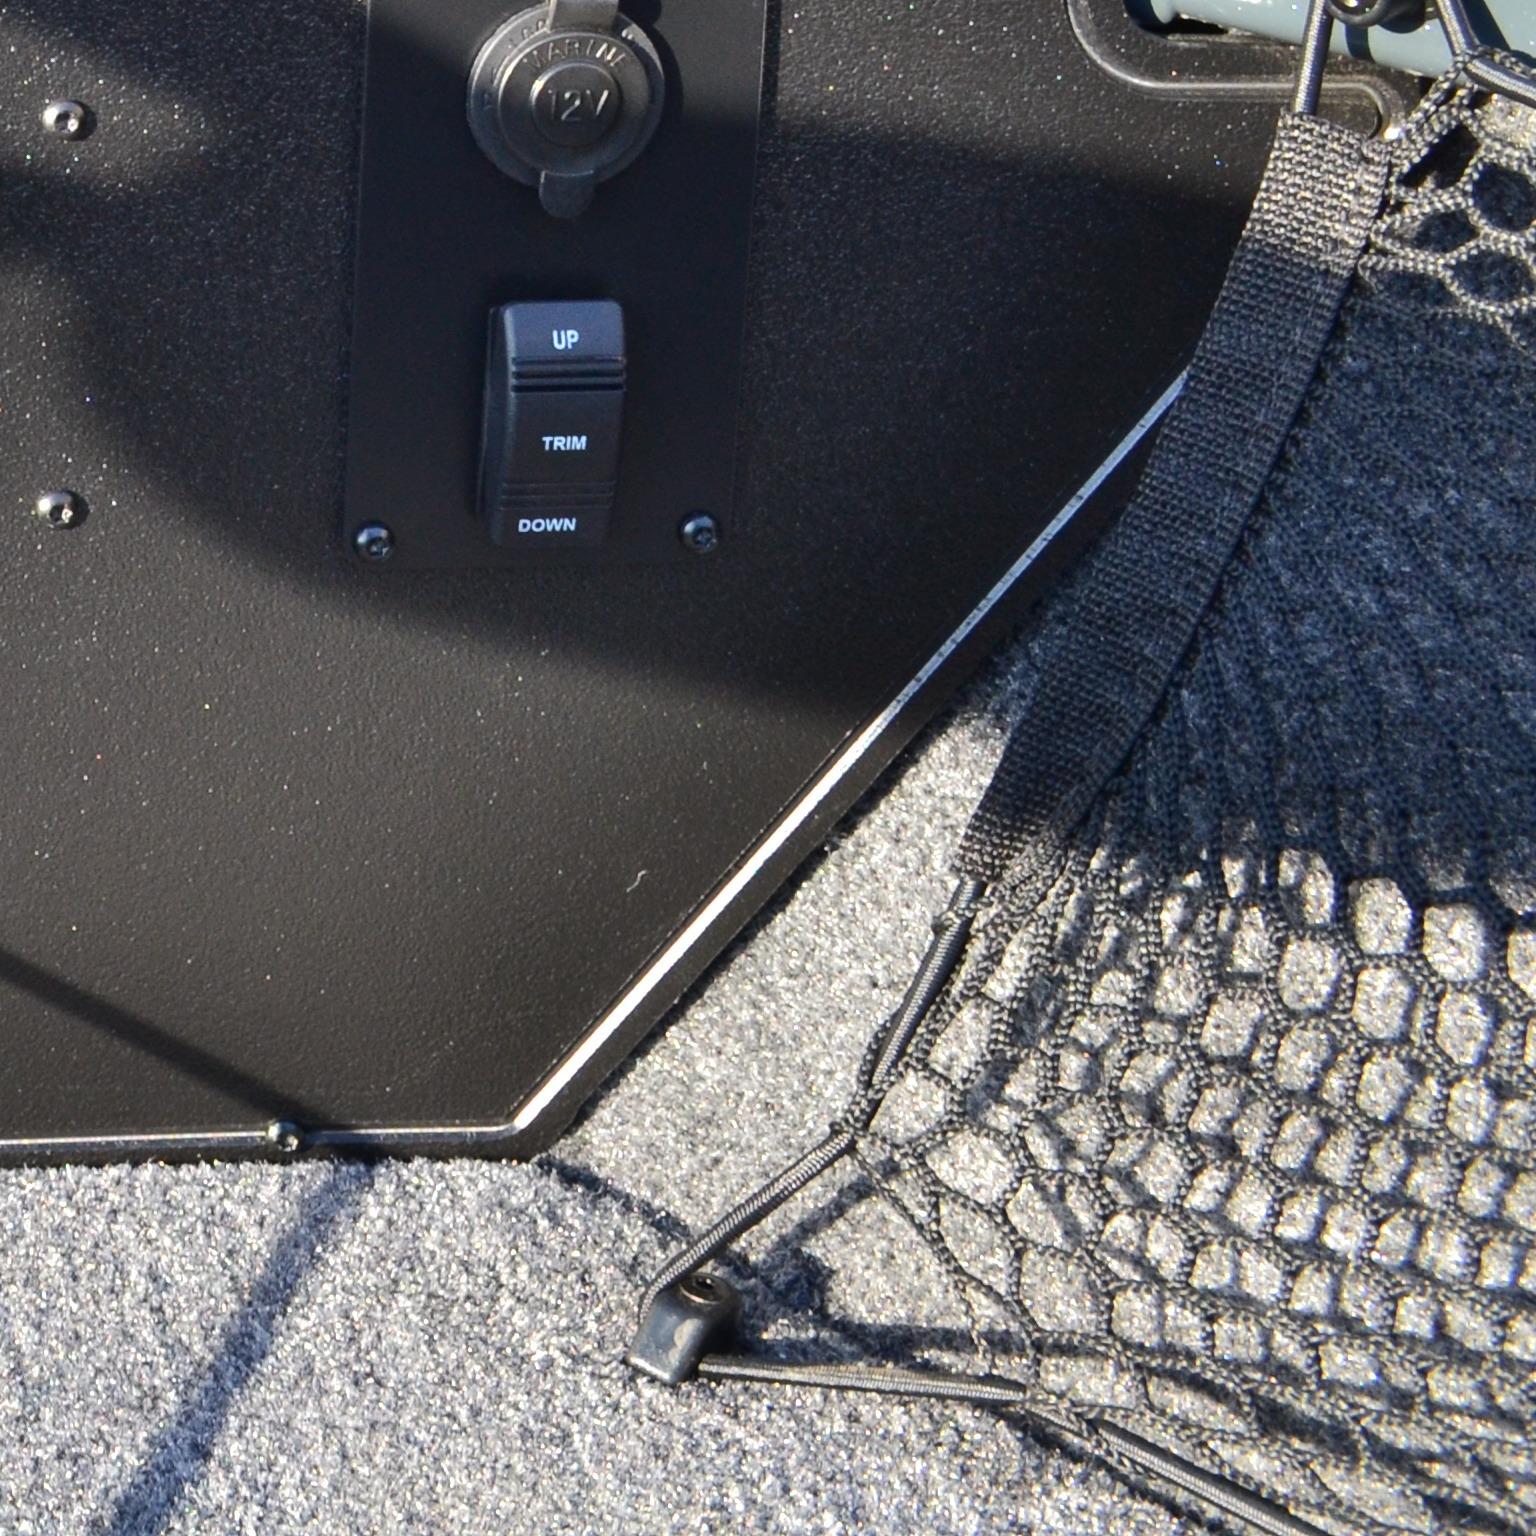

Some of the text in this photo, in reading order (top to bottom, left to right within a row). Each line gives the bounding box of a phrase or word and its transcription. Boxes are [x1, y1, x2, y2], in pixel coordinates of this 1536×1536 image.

[547, 88, 610, 122] 12V
[551, 329, 580, 350] UP
[541, 435, 588, 452] TRIM
[517, 517, 577, 533] DOWN
